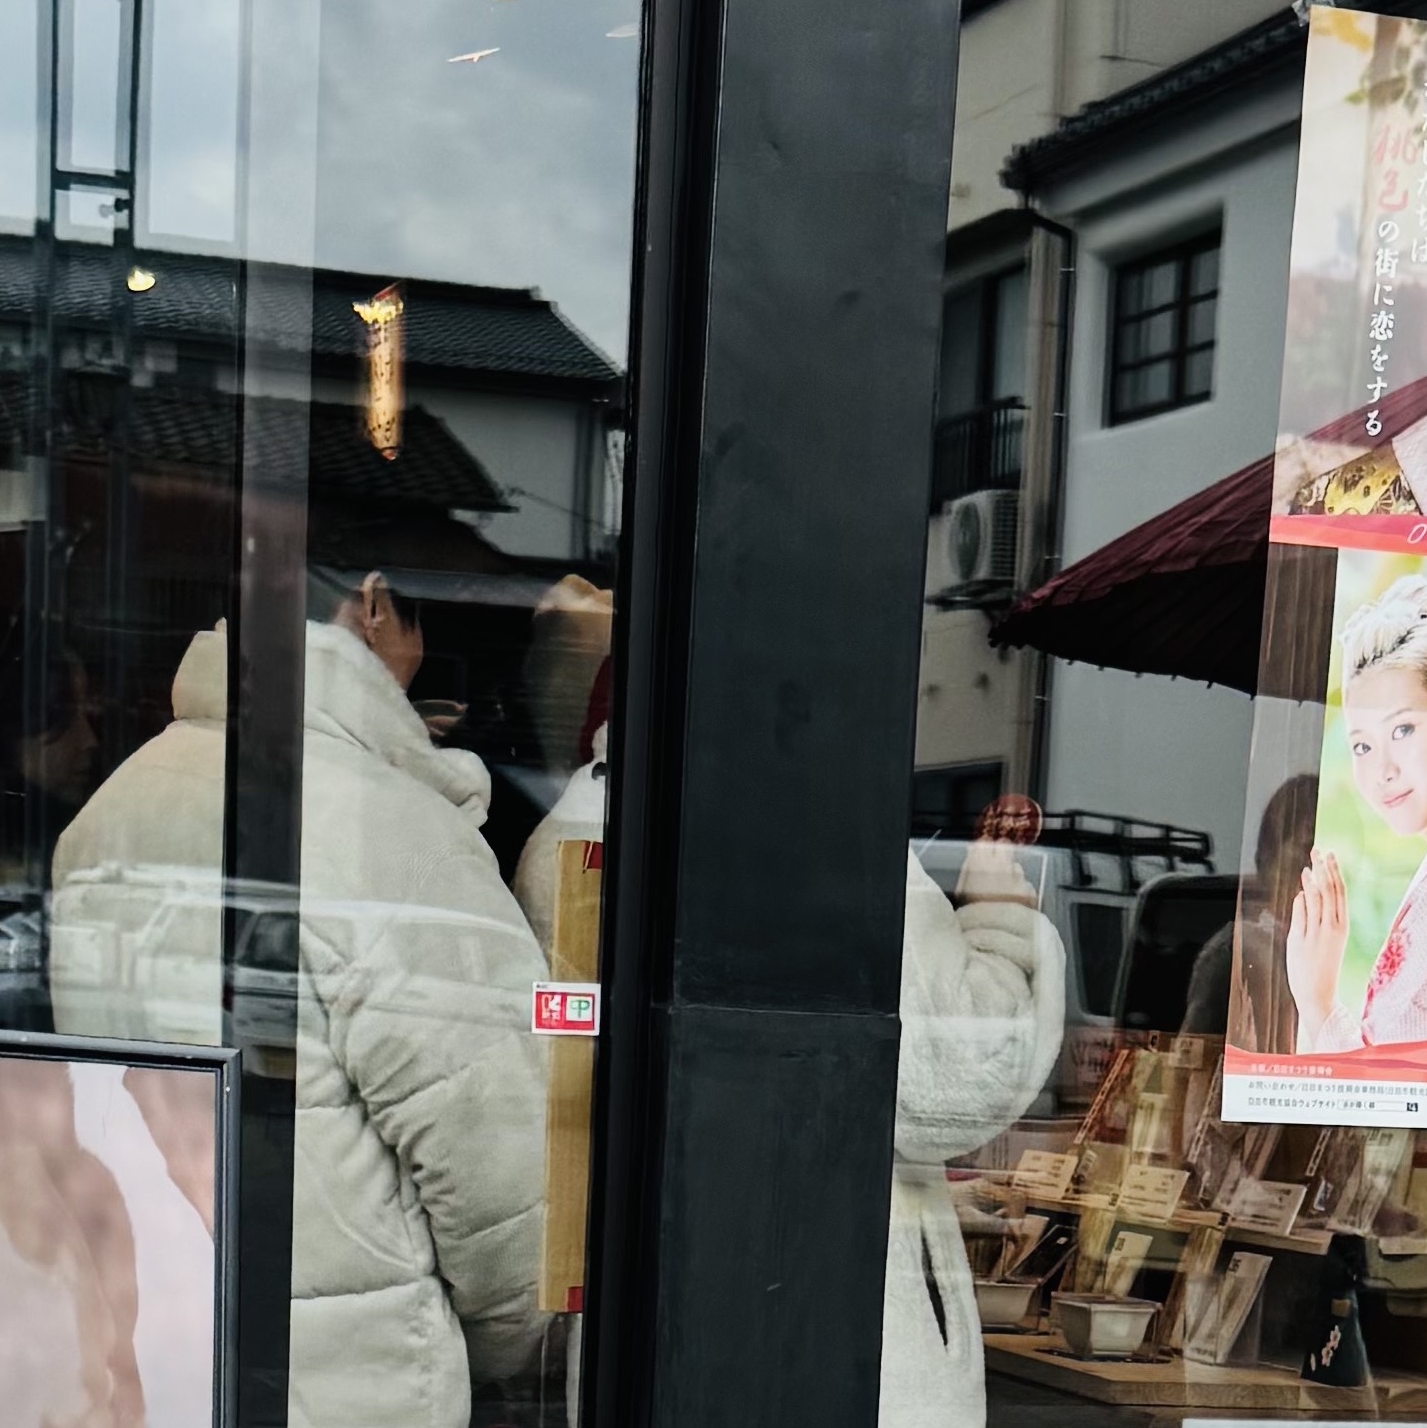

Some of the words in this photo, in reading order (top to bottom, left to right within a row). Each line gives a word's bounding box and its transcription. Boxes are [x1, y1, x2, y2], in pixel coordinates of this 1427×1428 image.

[1365, 123, 1419, 437] 桃色の街に恋をする
